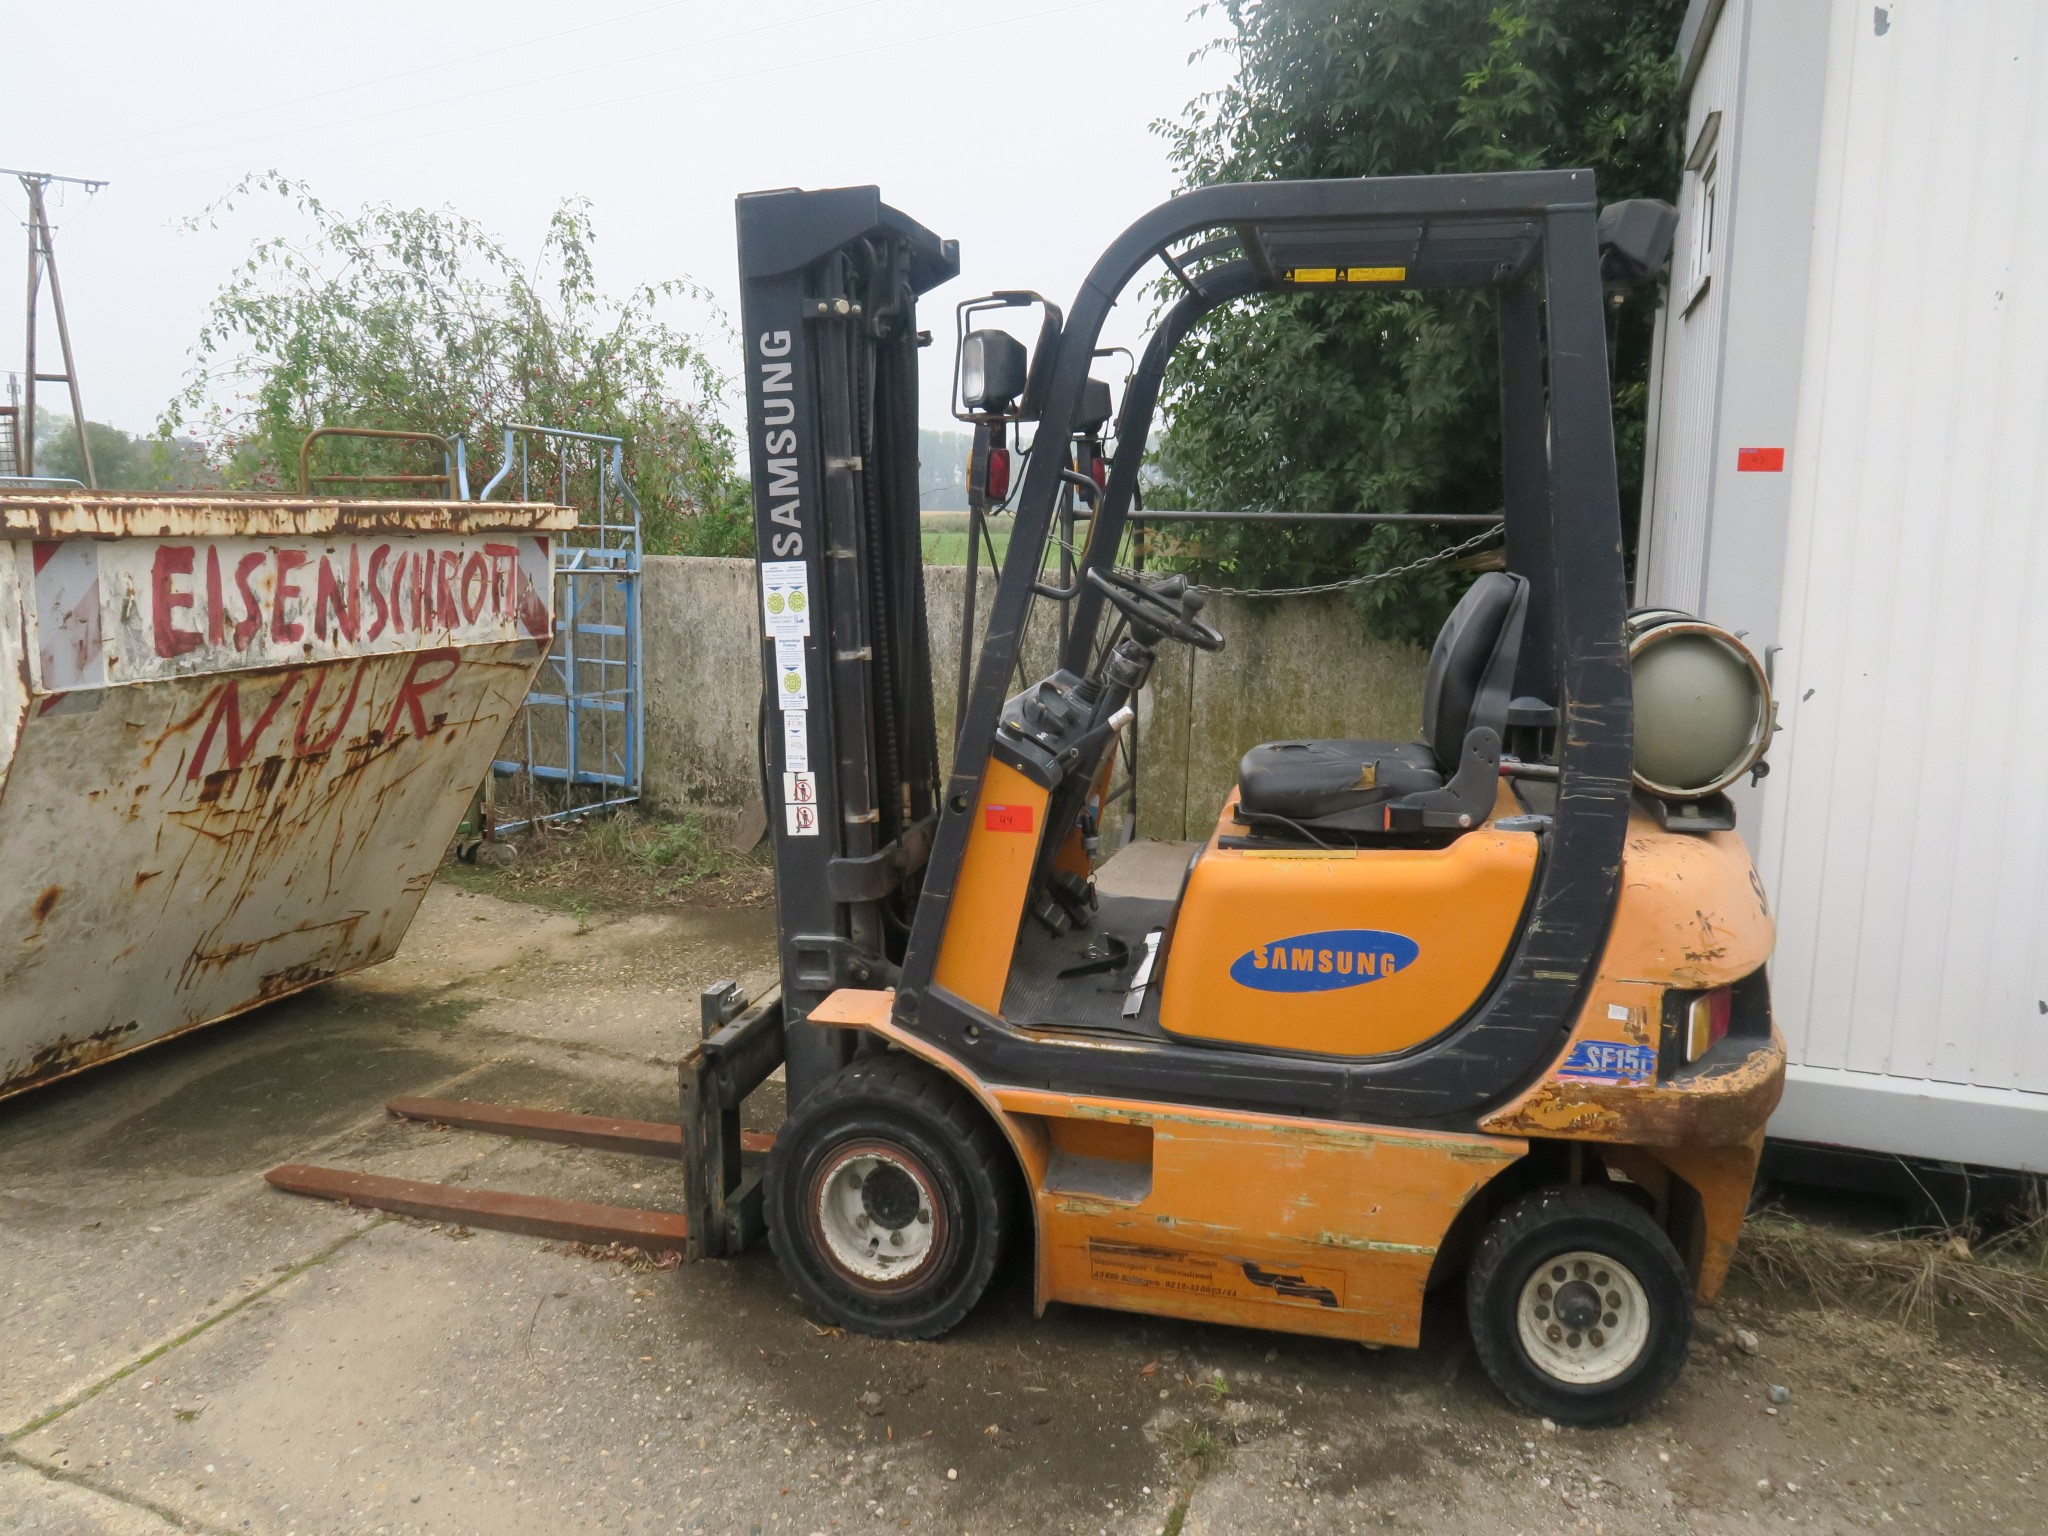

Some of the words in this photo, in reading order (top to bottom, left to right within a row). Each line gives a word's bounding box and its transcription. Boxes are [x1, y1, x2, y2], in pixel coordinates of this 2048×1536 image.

[760, 330, 803, 556] SAMSUNG
[152, 543, 519, 658] EISENSCHROTT
[187, 647, 460, 780] NUR
[1000, 813, 1012, 826] 44
[1253, 945, 1395, 977] SAMSUNG
